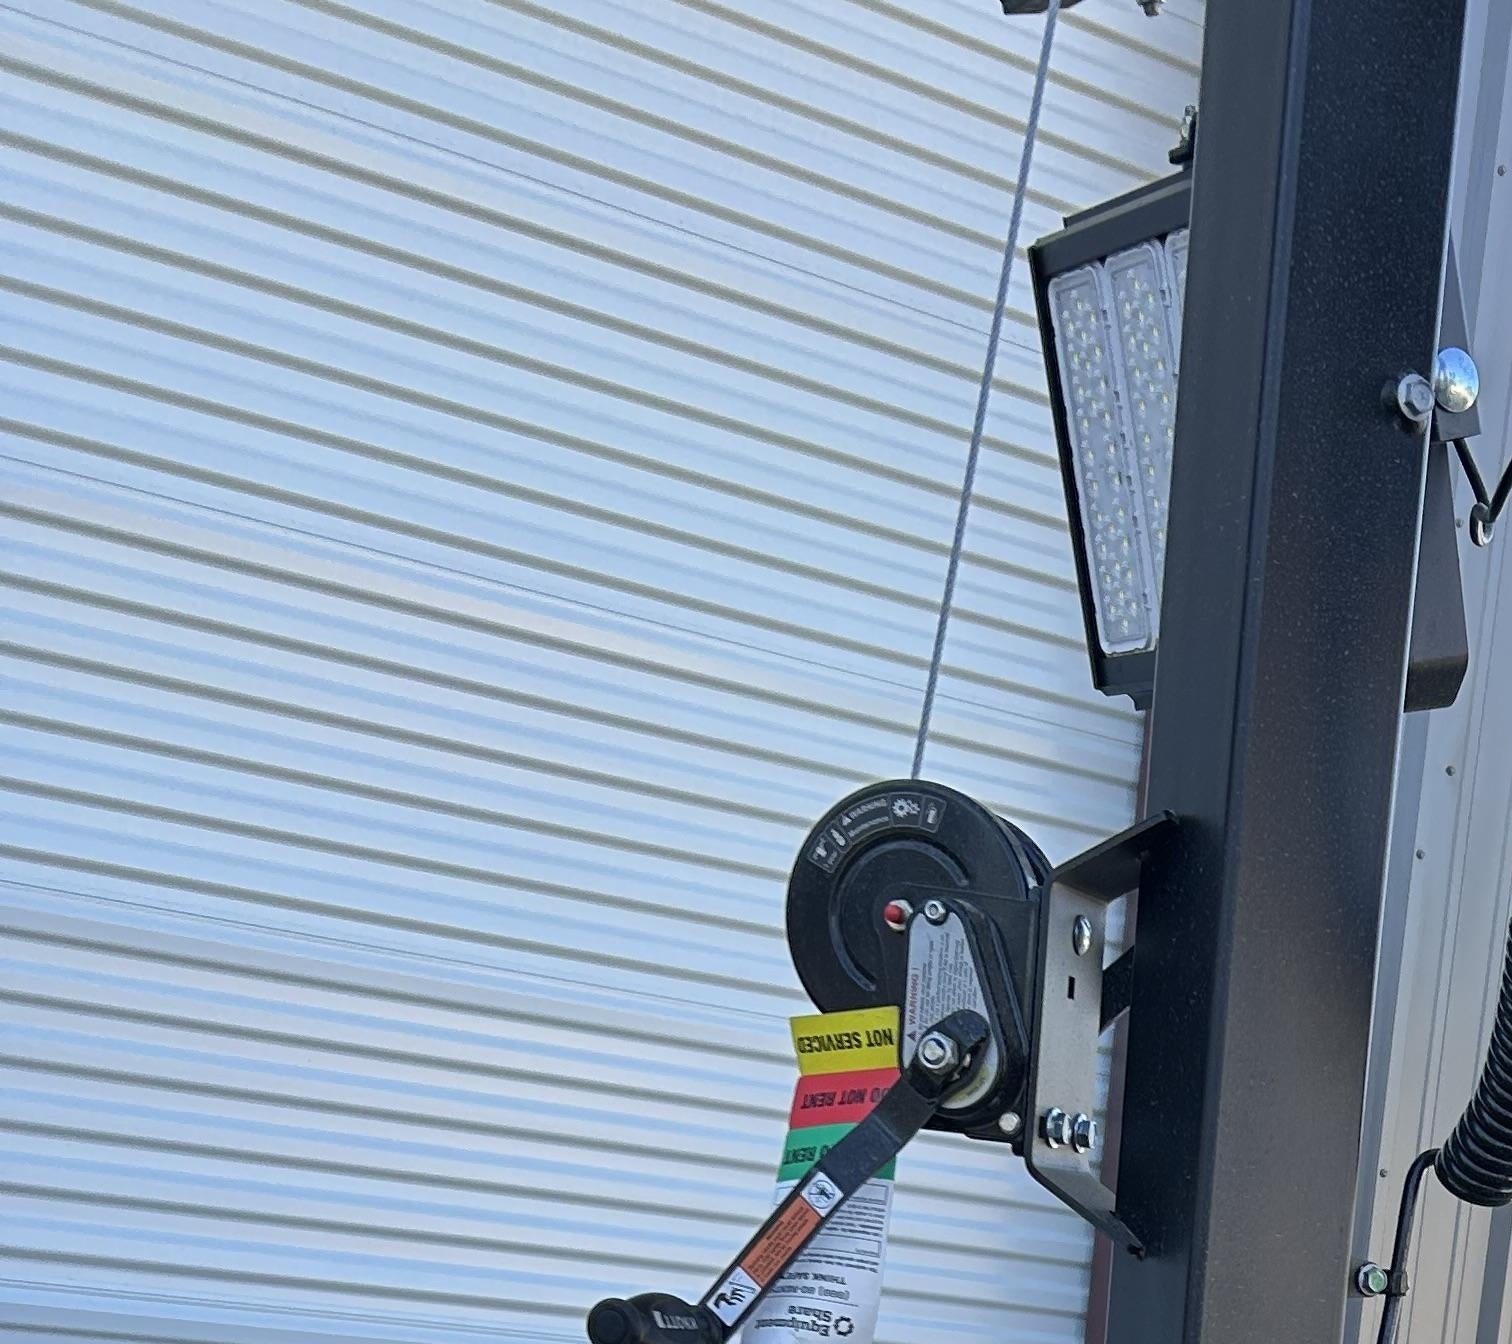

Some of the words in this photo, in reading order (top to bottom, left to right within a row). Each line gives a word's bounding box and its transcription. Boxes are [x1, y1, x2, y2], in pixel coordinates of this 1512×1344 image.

[798, 1031, 862, 1054] SERVICED
[866, 1028, 895, 1048] NOT
[801, 1092, 837, 1110] RENT
[838, 1088, 868, 1105] NOT
[783, 1146, 817, 1165] RENT
[788, 1305, 833, 1322] Share
